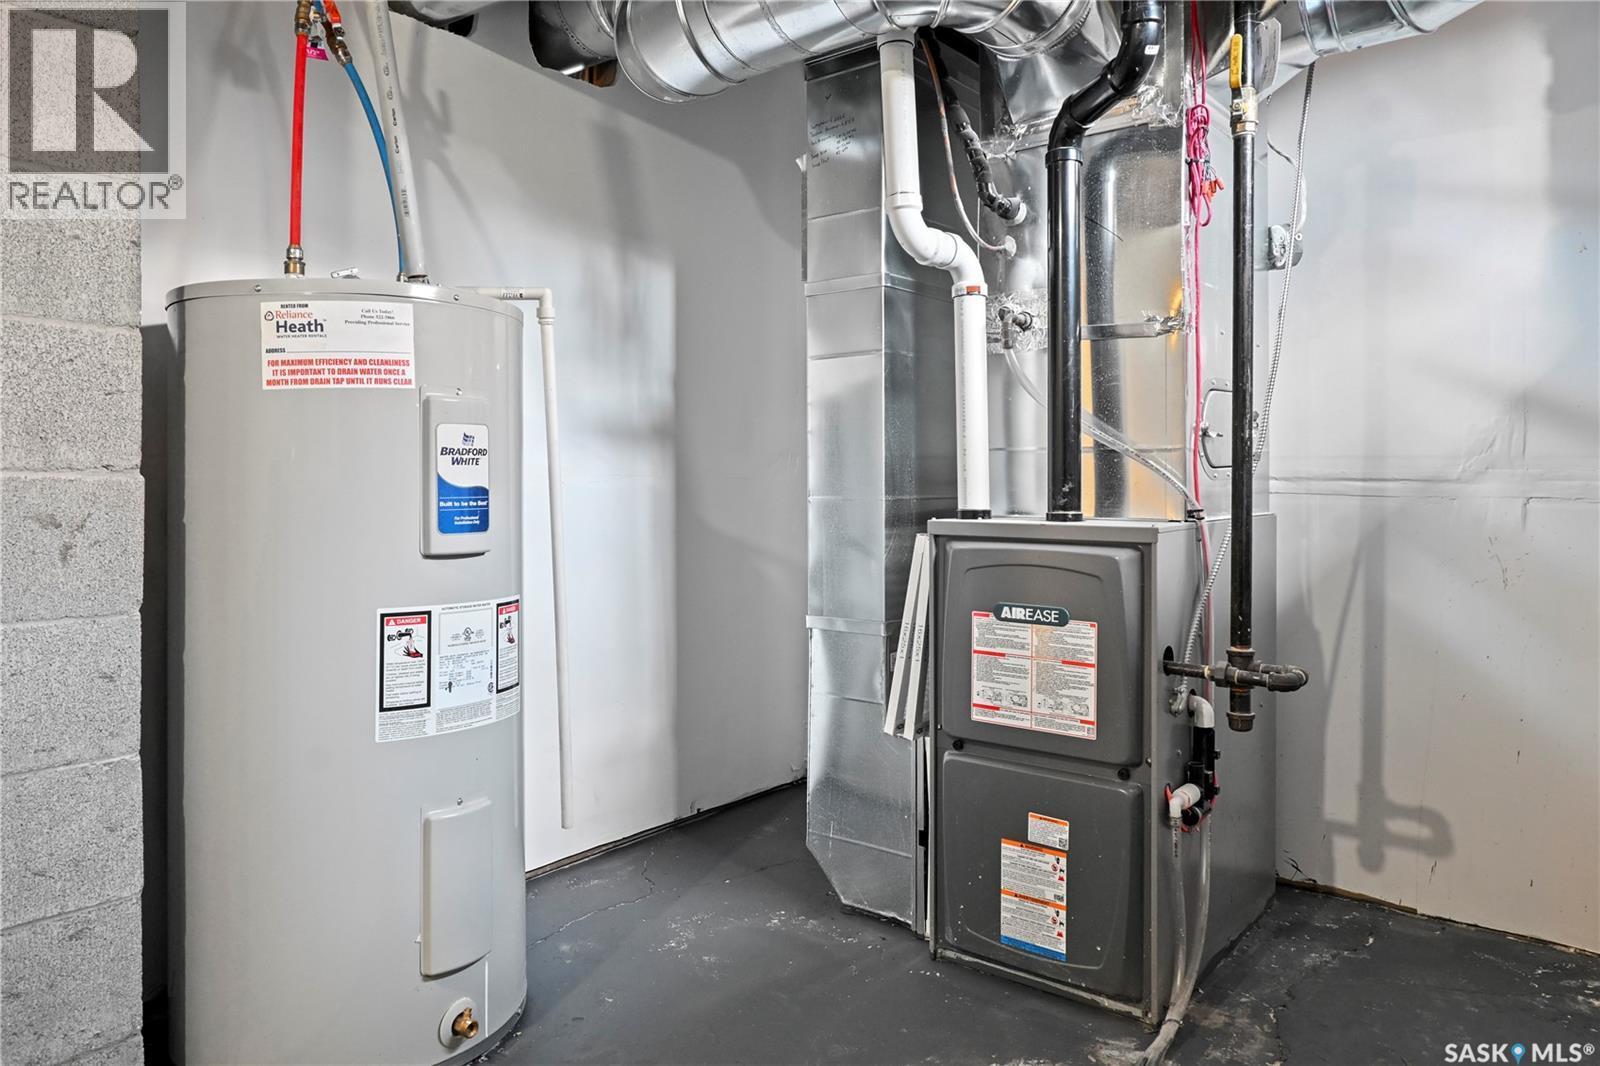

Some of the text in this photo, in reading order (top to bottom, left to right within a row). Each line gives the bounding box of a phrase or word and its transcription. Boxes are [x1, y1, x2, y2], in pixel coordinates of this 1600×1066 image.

[276, 310, 313, 319] Reliance
[440, 446, 488, 456] BRADFORD
[451, 457, 480, 466] WHITE
[1000, 606, 1059, 622] AIREASE
